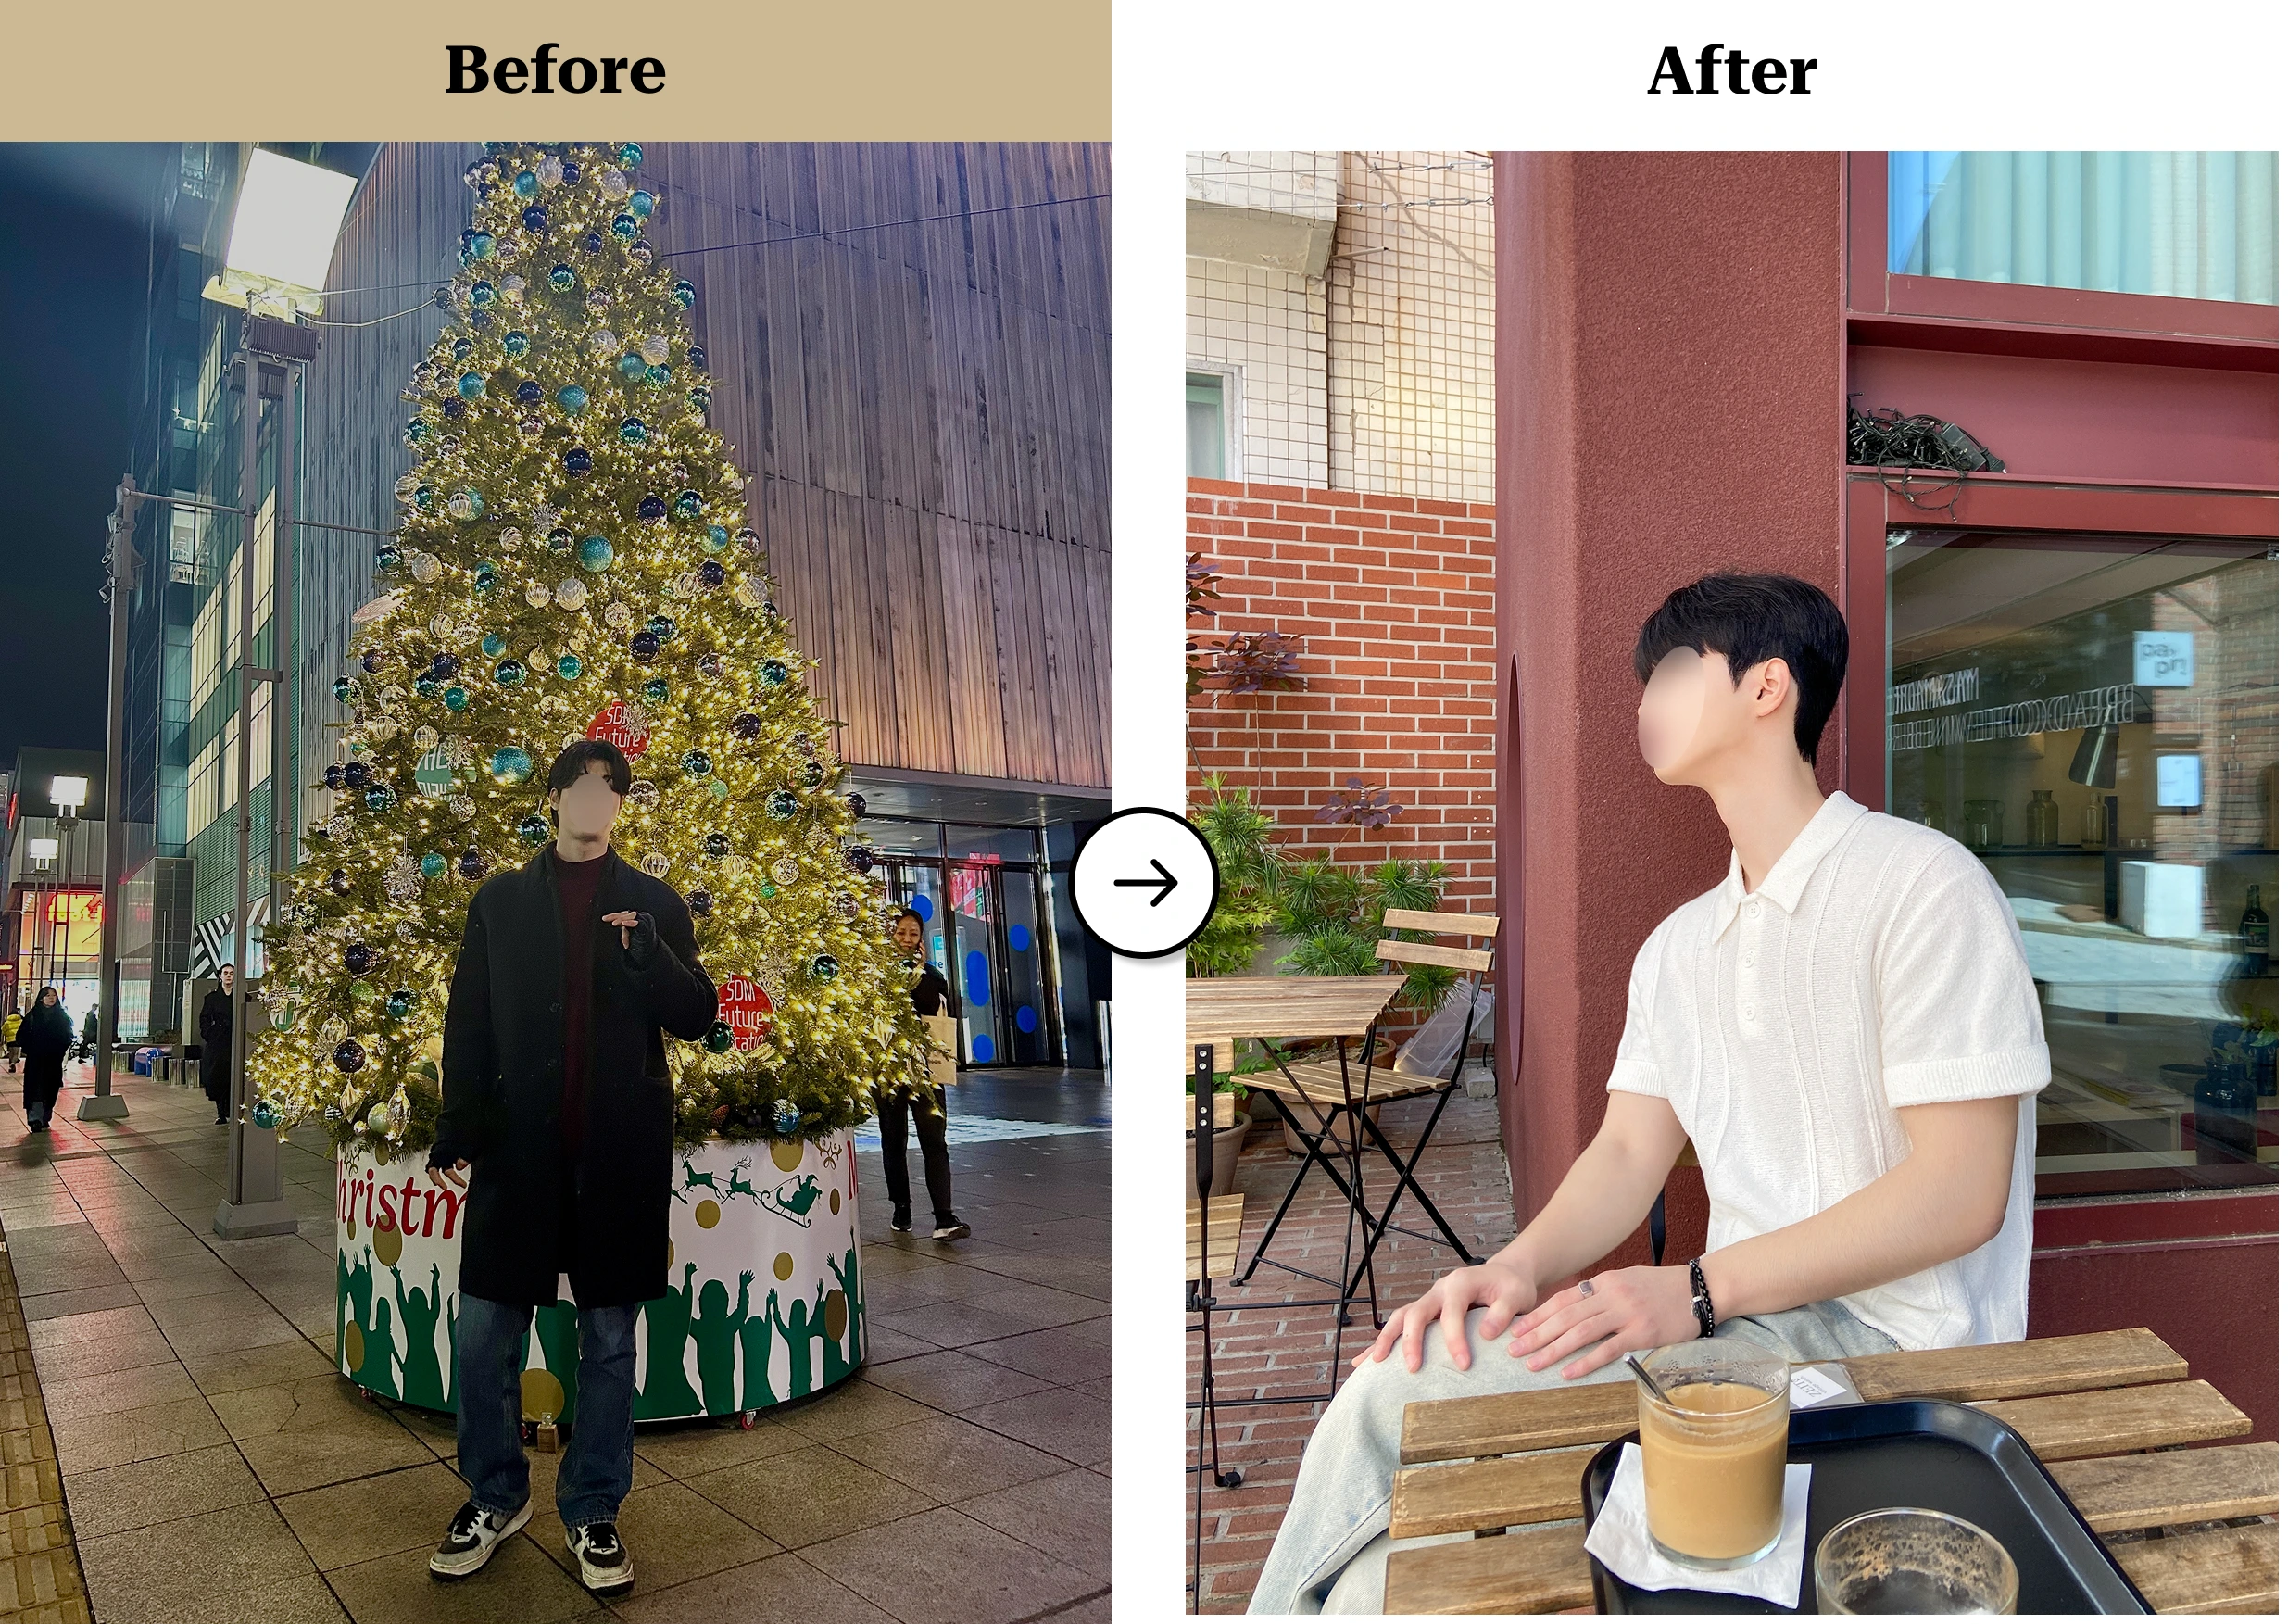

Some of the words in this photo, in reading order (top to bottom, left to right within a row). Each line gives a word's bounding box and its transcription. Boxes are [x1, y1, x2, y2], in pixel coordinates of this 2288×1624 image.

[725, 979, 756, 1002] SDM
[717, 1002, 764, 1028] Future
[734, 1029, 768, 1051] catio
